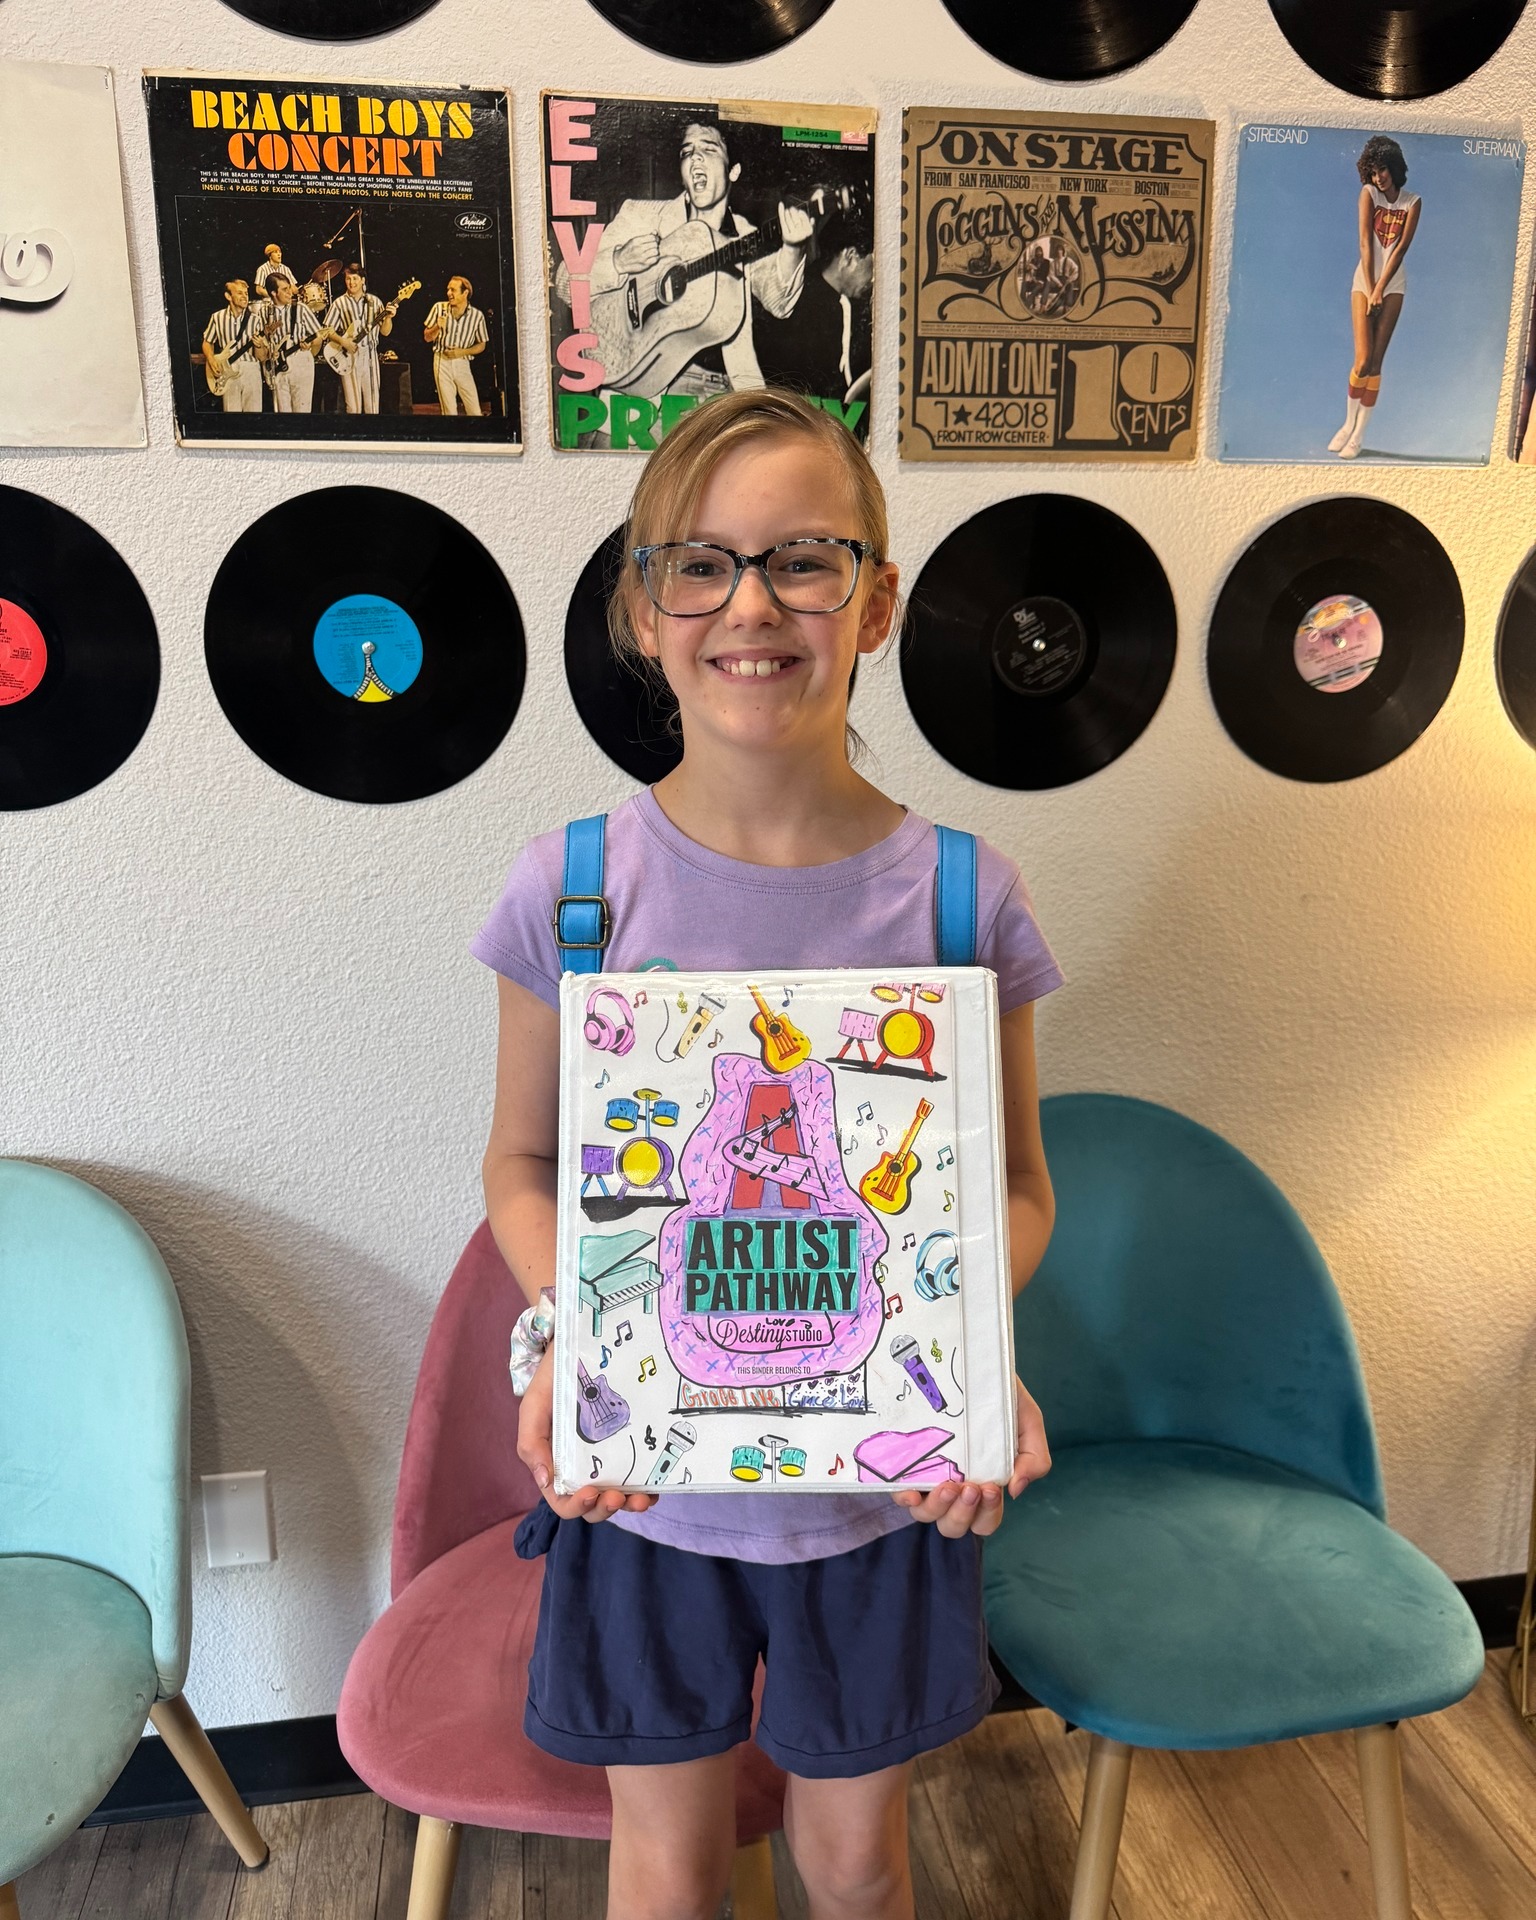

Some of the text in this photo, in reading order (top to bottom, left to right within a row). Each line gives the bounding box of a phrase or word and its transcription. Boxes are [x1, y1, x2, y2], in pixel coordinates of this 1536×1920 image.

[191, 90, 474, 139] BEACH BOYS
[795, 130, 828, 138] LPM-1254
[228, 132, 443, 177] CONCERT
[1024, 133, 1184, 175] STAGE
[1248, 126, 1309, 145] STREISAND
[1462, 139, 1521, 160] SUPERMAN
[924, 171, 952, 187] FROM
[958, 173, 978, 188] SAN
[979, 174, 1031, 190] FRANCISCO
[1059, 177, 1082, 192] NEW
[1083, 178, 1108, 193] YORK
[1134, 181, 1170, 196] BOSTON
[549, 99, 606, 393] ELVIS
[1065, 343, 1194, 440] 10
[936, 430, 1046, 444] FRONT ROW CENTER
[1117, 401, 1187, 447] CENTS
[687, 1219, 858, 1271] ARTIST
[686, 1272, 858, 1312] PATHWAY
[737, 1366, 812, 1375] THIS BINDER BELONGS TO
